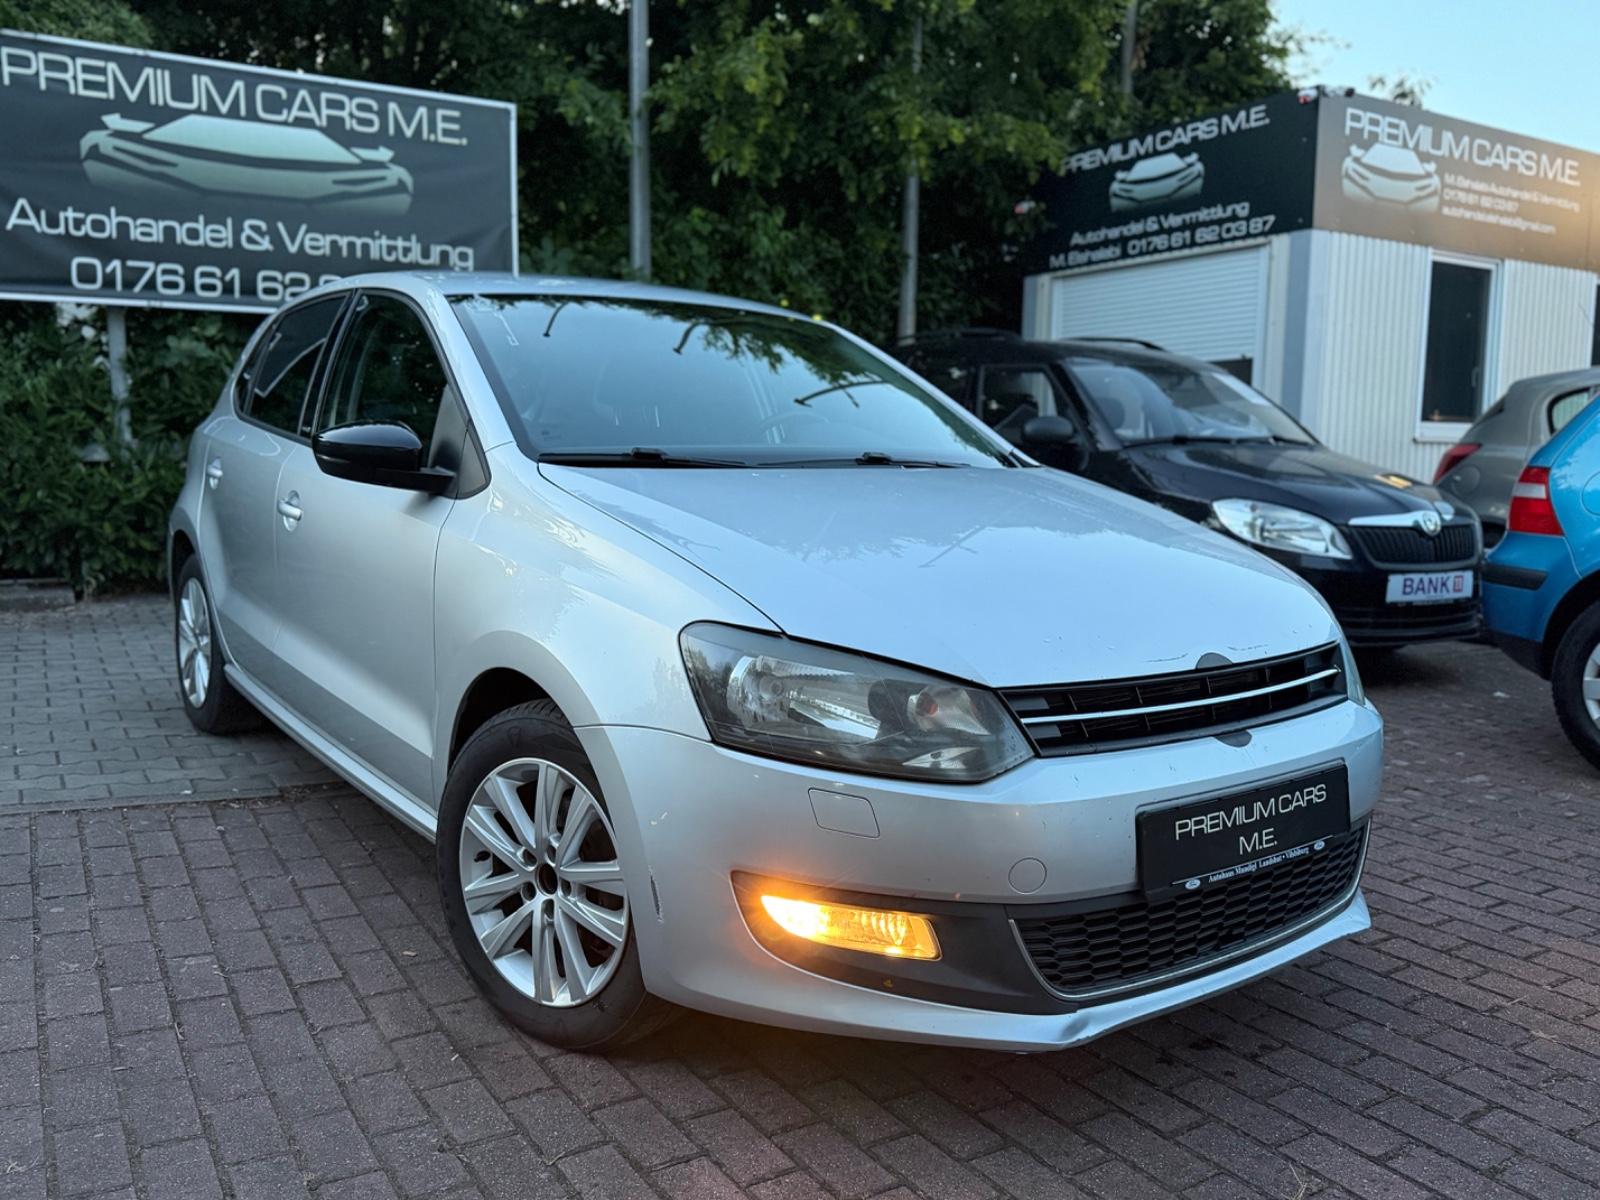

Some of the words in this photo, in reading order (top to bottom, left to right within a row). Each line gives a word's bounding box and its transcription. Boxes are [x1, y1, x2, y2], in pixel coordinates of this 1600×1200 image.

[2, 47, 245, 117] PREMIUM
[256, 84, 379, 134] CARS
[388, 105, 468, 146] M.E.
[1156, 117, 1218, 151] CARS
[1220, 104, 1271, 135] M.E.
[1345, 107, 1469, 162] PREMIUM
[1472, 138, 1538, 177] CARS
[6, 198, 233, 250] Autohandel
[241, 219, 273, 252] &
[277, 221, 474, 272] Vermittlung
[1127, 233, 1169, 255] 0176
[1170, 230, 1191, 248] 61
[1195, 225, 1220, 244] 62
[1221, 220, 1248, 239] 03
[1249, 214, 1277, 235] 87
[71, 256, 185, 296] 0176
[194, 266, 240, 298] 61
[256, 270, 310, 301] 62
[1175, 799, 1276, 840] PREMIUM
[1278, 784, 1327, 813] CARS
[1239, 828, 1278, 855] M.E.
